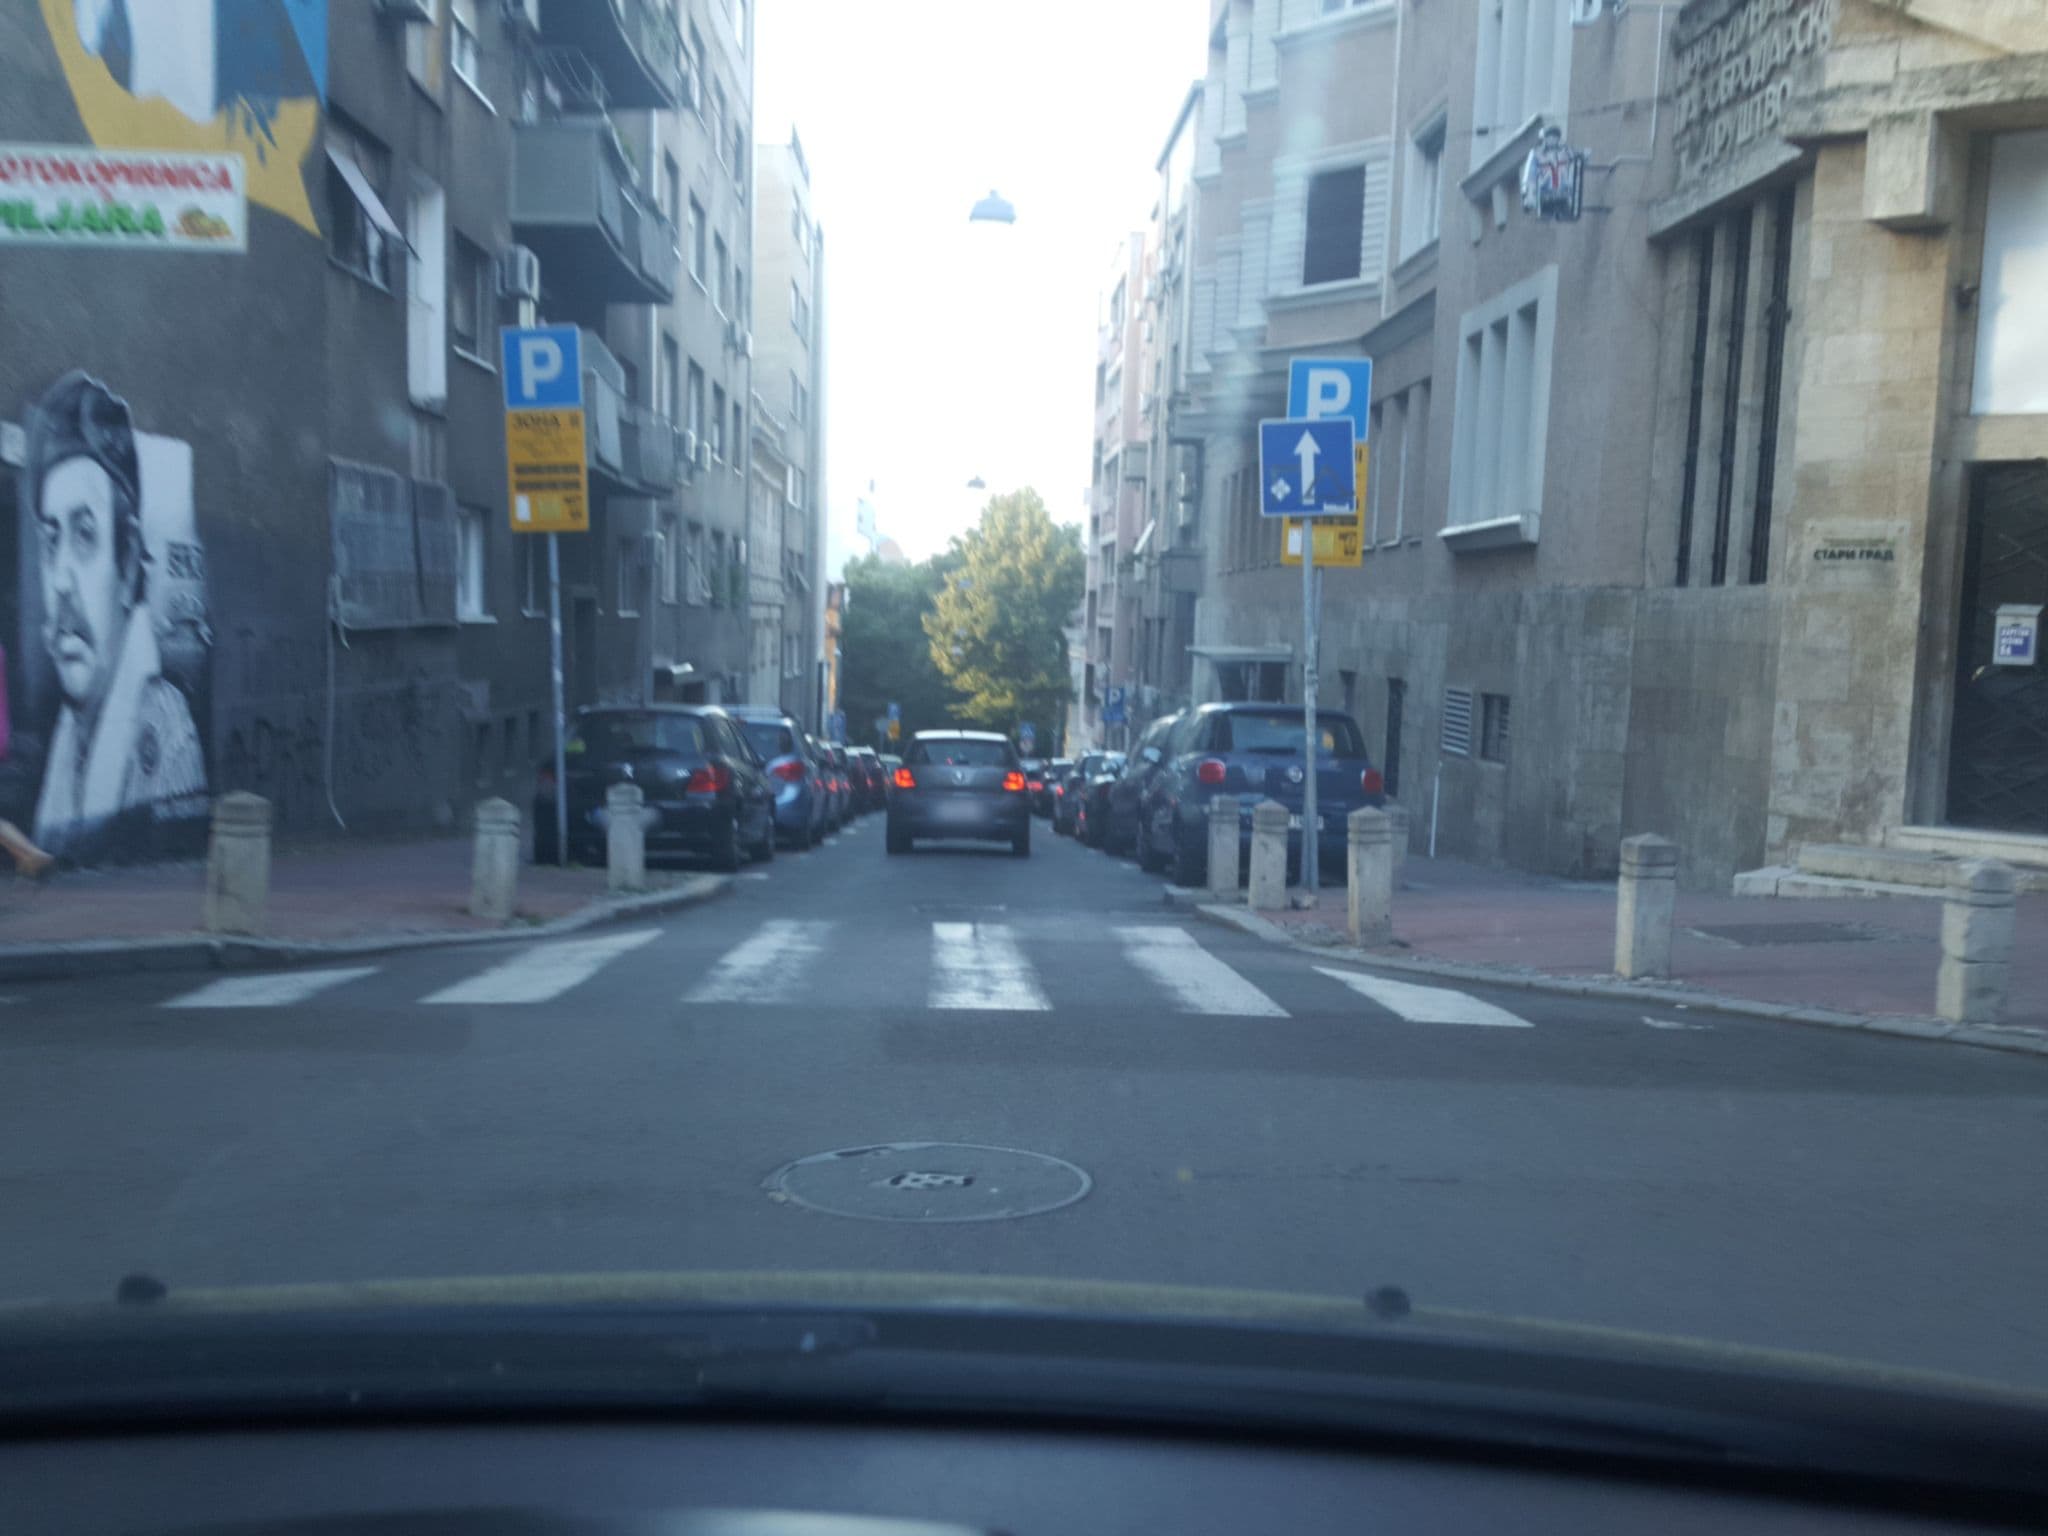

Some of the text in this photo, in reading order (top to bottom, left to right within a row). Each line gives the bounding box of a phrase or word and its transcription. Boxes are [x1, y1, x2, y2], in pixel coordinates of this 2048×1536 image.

[519, 338, 563, 400] P
[1306, 367, 1351, 421] P
[1813, 549, 1894, 562] СТАРИ ГРАД
